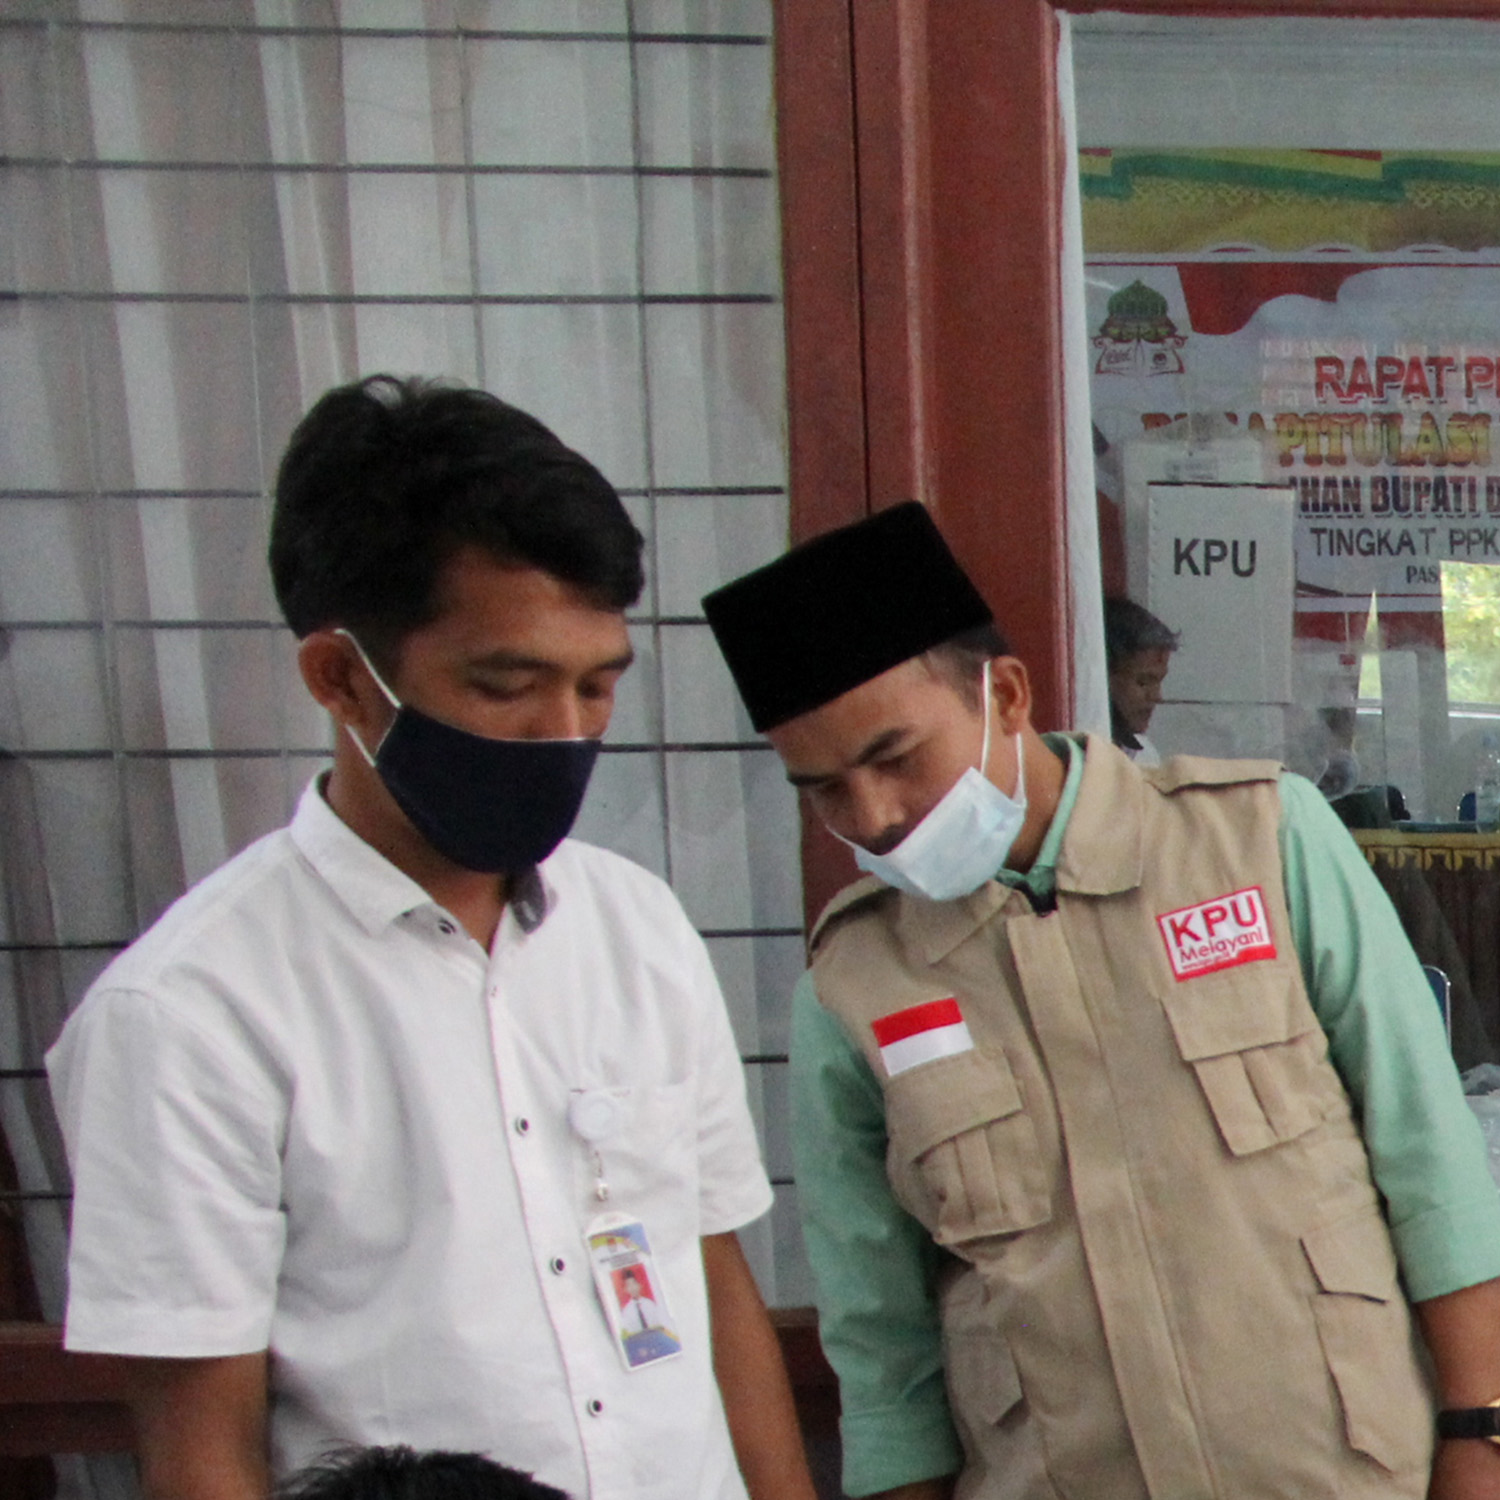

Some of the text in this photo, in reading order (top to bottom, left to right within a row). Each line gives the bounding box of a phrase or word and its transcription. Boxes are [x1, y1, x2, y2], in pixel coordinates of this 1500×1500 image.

[1314, 355, 1455, 402] RAPAT
[1370, 475, 1477, 515] BUPATI
[1173, 537, 1257, 577] KPU
[1310, 527, 1436, 557] TINGKAT
[1449, 528, 1499, 556] PPK
[1168, 894, 1258, 948] KPU
[1180, 926, 1265, 962] Melayani
